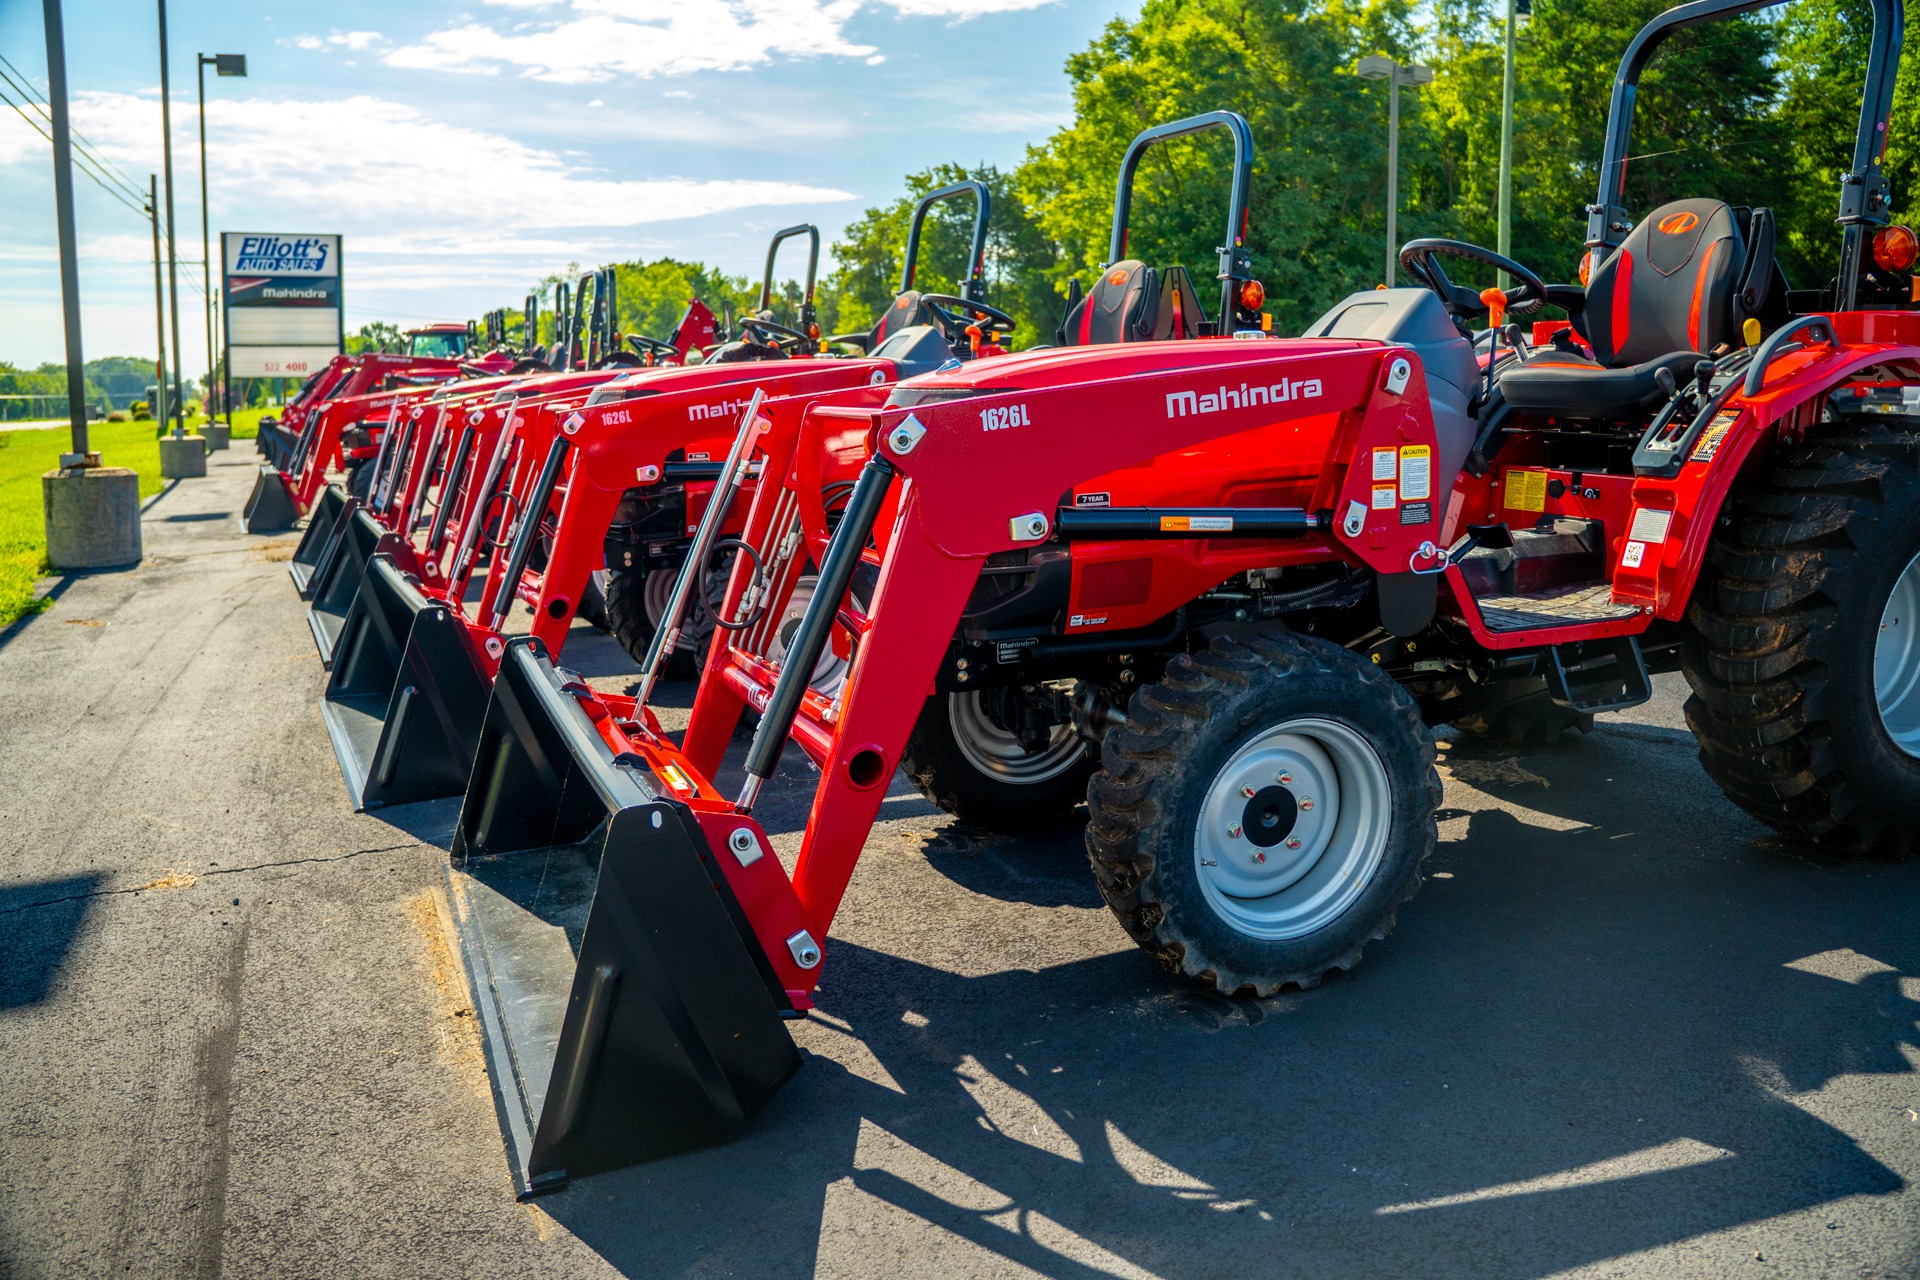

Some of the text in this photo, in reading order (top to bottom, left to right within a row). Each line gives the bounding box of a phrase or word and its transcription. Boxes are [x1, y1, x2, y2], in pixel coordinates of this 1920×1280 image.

[239, 237, 329, 258] Elliott's
[242, 259, 318, 271] AUTO SALES
[262, 288, 327, 299] Mahindra
[1166, 377, 1322, 419] Mahindra
[600, 410, 632, 427] 1626L
[979, 404, 1031, 432] 1626L
[1000, 641, 1036, 650] Mahindra
